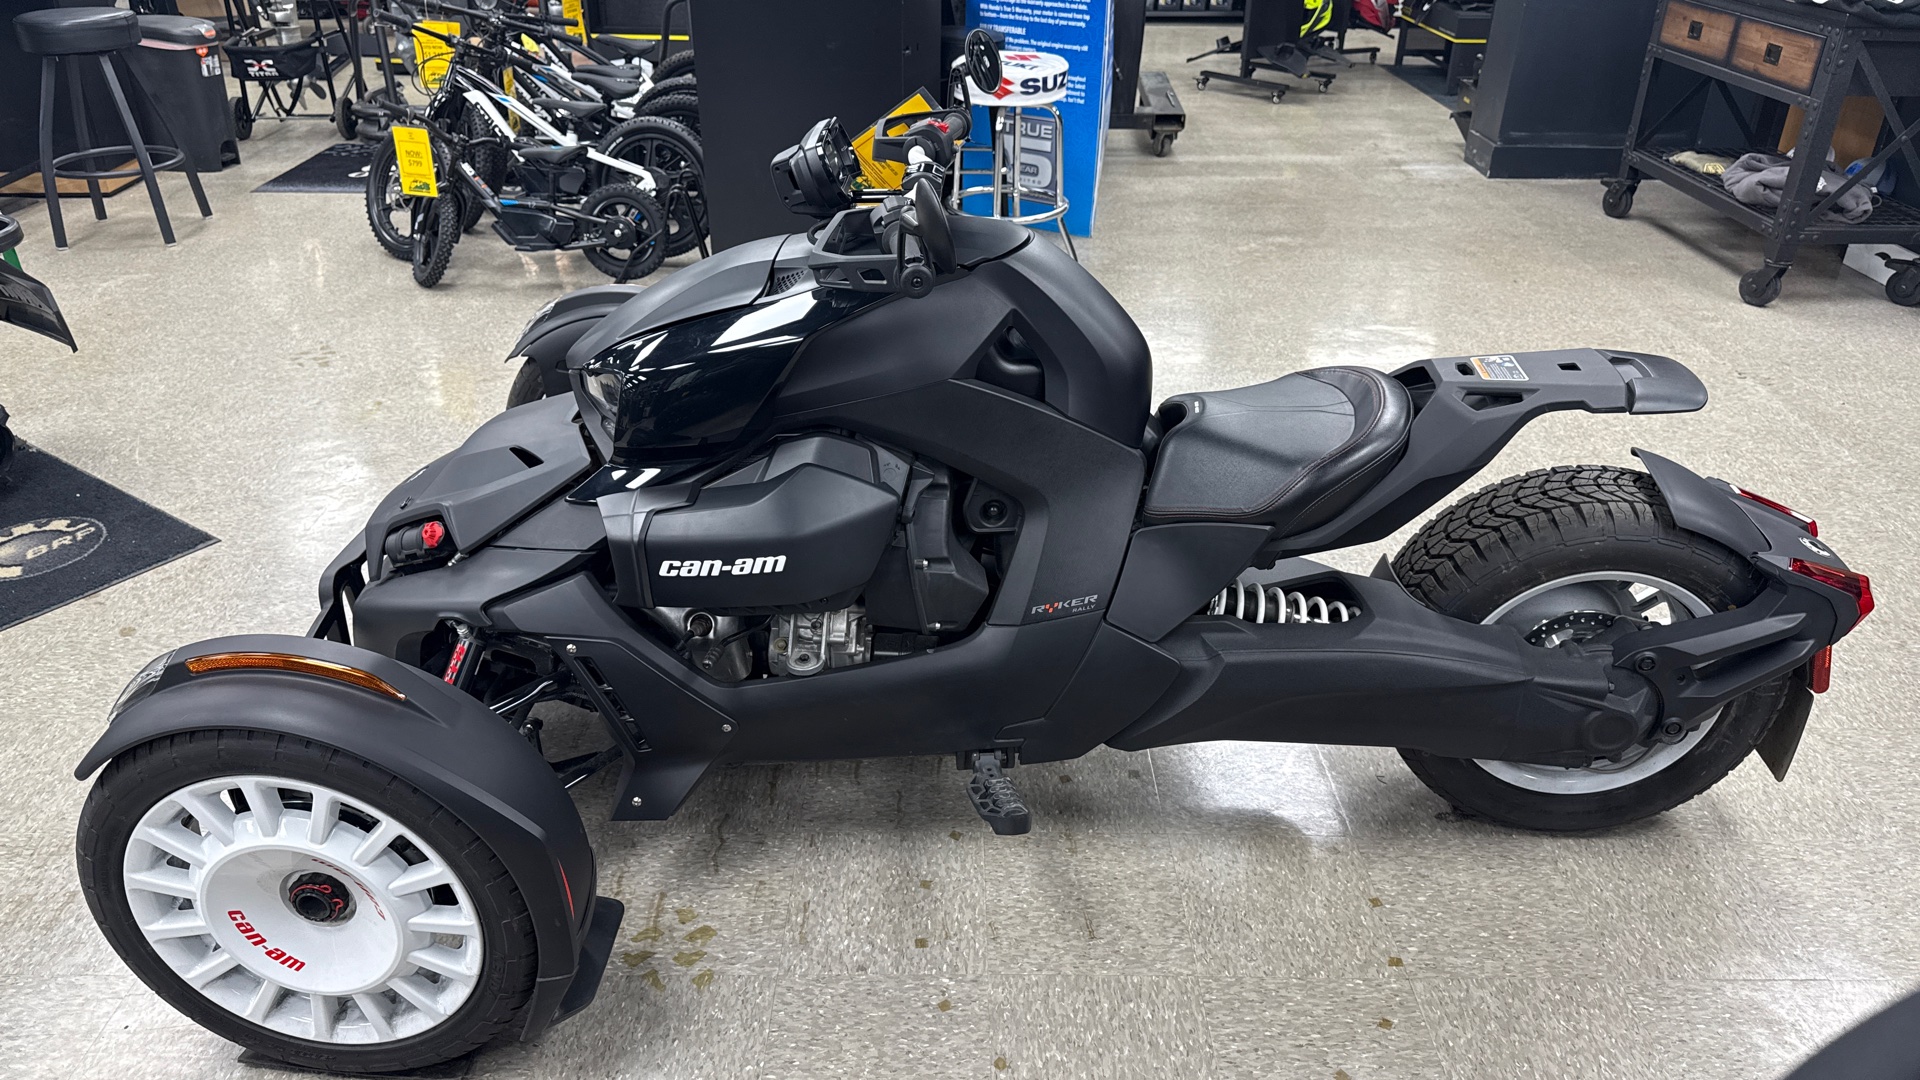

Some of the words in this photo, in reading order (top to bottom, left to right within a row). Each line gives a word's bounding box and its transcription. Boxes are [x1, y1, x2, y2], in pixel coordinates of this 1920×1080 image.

[26, 526, 96, 560] BRP
[658, 554, 787, 577] can-am
[1031, 594, 1098, 614] RYKER
[1072, 603, 1096, 613] RALLY
[227, 909, 306, 972] can-am
